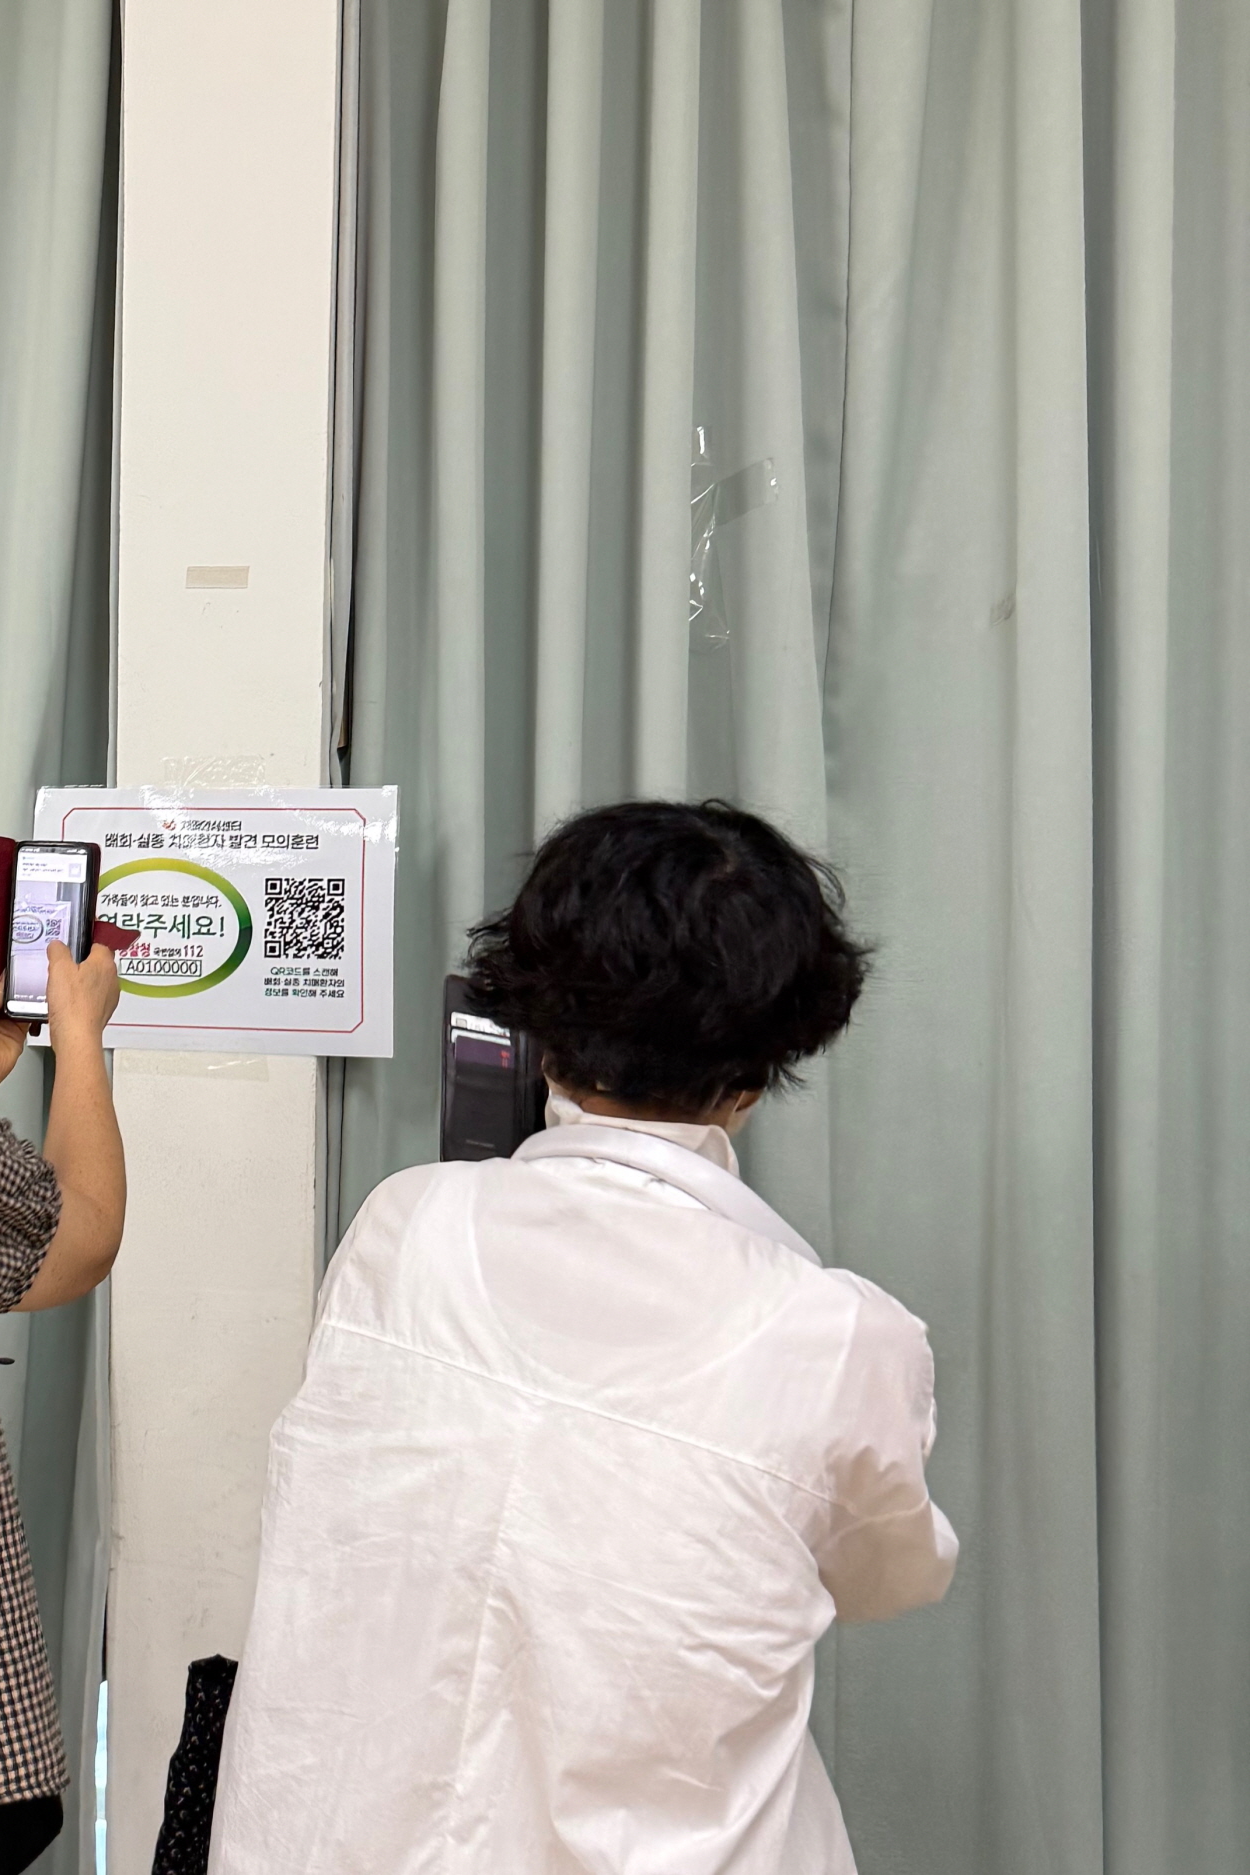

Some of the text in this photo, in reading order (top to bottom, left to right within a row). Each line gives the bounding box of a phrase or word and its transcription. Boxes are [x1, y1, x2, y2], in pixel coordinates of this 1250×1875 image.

[104, 832, 165, 849] 배회·실종
[229, 833, 258, 850] 발견
[260, 833, 320, 850] 모의훈련
[100, 893, 139, 907] 가족들이
[139, 894, 160, 908] 찾고
[160, 894, 179, 908] 있는
[183, 944, 204, 958] 112
[125, 961, 199, 975] A0100000
[270, 966, 339, 977] QR코드를 스캔해
[264, 987, 345, 999] 정보를 확인해 주세요
